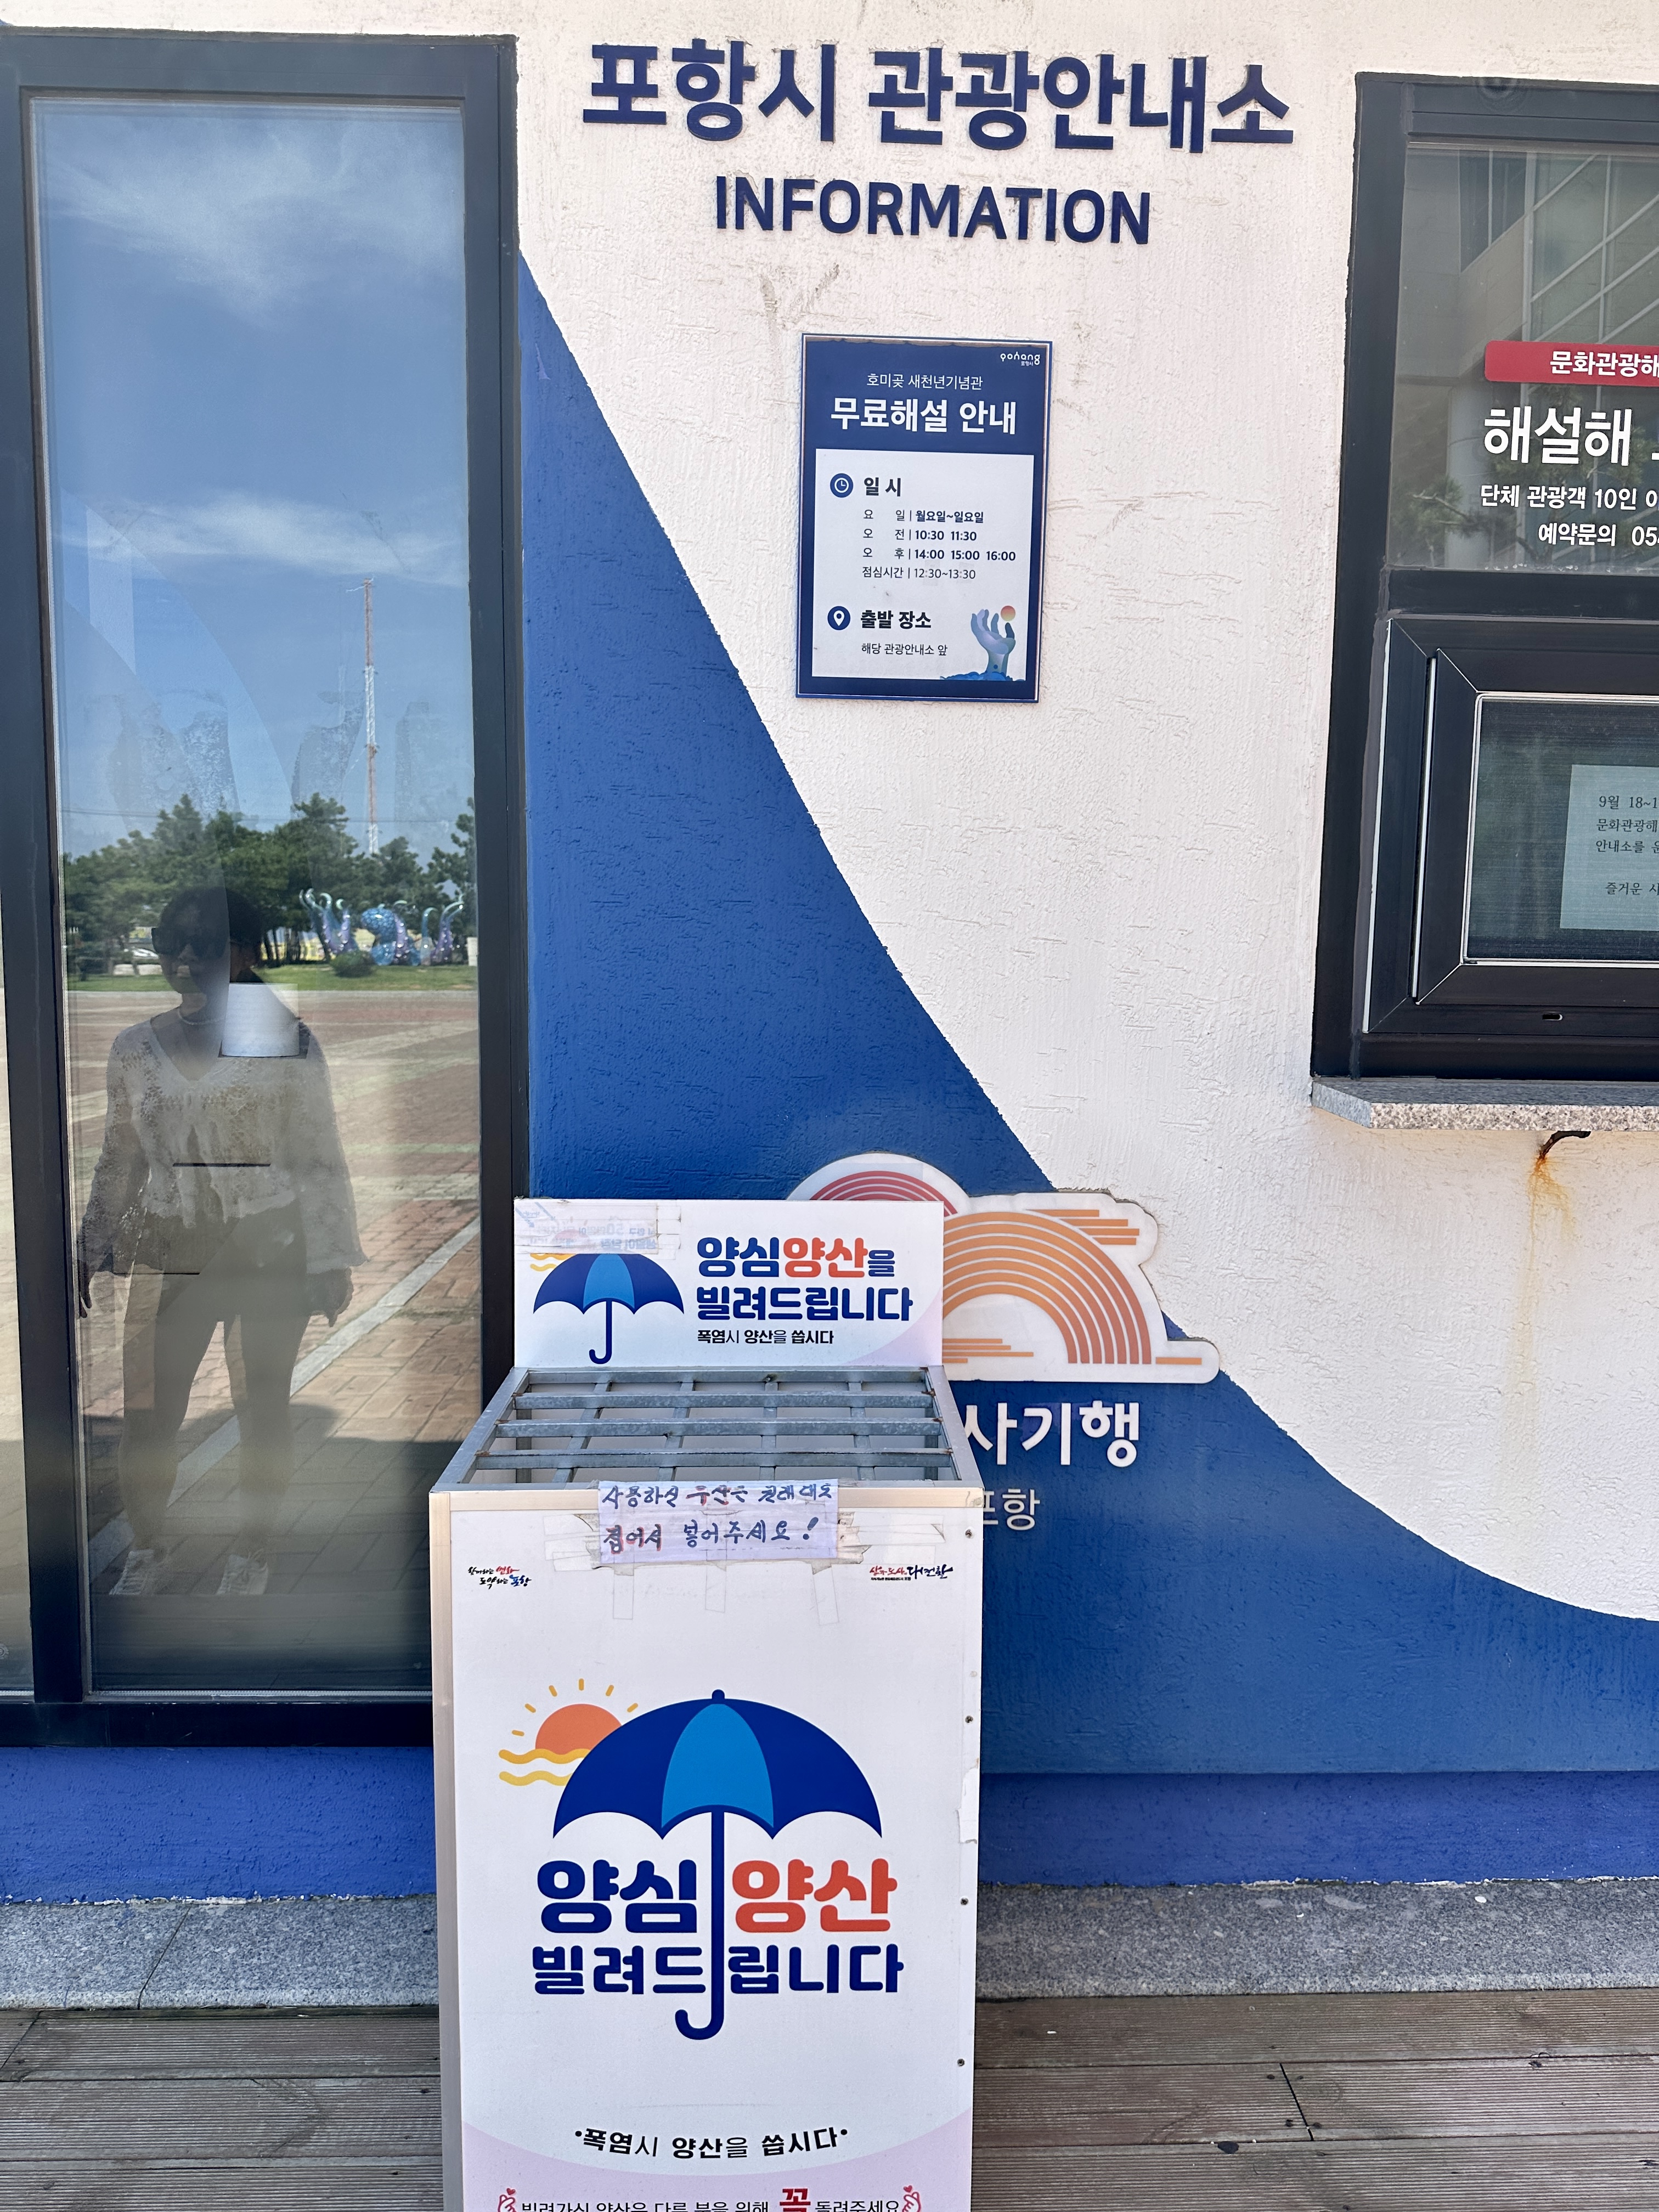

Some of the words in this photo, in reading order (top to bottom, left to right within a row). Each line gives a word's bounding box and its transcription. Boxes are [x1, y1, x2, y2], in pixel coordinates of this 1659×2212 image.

[583, 38, 837, 143] 포항시
[868, 47, 1294, 153] 관광안내소
[716, 174, 1151, 245] INFORMATION
[1550, 351, 1659, 379] 문화관광해
[866, 373, 905, 388] 호미곶
[908, 374, 983, 390] 새천년기념관
[831, 397, 948, 433] 무료해설
[959, 401, 1017, 435] 안내
[1483, 405, 1633, 467] 해설해
[1481, 484, 1520, 507] 단체
[1527, 485, 1586, 509] 관광객
[1594, 488, 1638, 511] 10인
[915, 510, 984, 523] 월요일~일요일
[915, 530, 945, 540] 10:30
[950, 531, 977, 541] 11:30
[1538, 522, 1617, 547] 예약문의
[1632, 525, 1659, 546] 05
[914, 549, 945, 559] 14:00
[951, 550, 980, 560] 15:00
[986, 551, 1016, 561] 16:00
[862, 566, 904, 579] 점심시간
[913, 568, 976, 579] 12:30~13:30
[860, 610, 893, 629] 출발
[898, 611, 932, 629] 장소
[861, 642, 881, 655] 해당
[884, 643, 934, 656] 관광안내소
[937, 644, 948, 657] 앞
[1599, 795, 1620, 810] 9월
[1596, 818, 1658, 833] 문화관광해
[1595, 839, 1645, 854] 안내소를
[1605, 882, 1643, 895] 즐거운
[697, 1236, 895, 1278] 양심양산을
[697, 1286, 913, 1322] 빌려드립니다
[697, 1329, 739, 1344] 폭염시
[744, 1329, 787, 1344] 양산을
[791, 1329, 834, 1344] 씁시다
[964, 1400, 1139, 1468] 사기행
[603, 1523, 662, 1555] 접어서
[509, 1574, 532, 1587] 포항
[583, 2128, 658, 2157] 폭염시
[672, 2136, 748, 2159] 양산을
[761, 2126, 838, 2157] 씁시다
